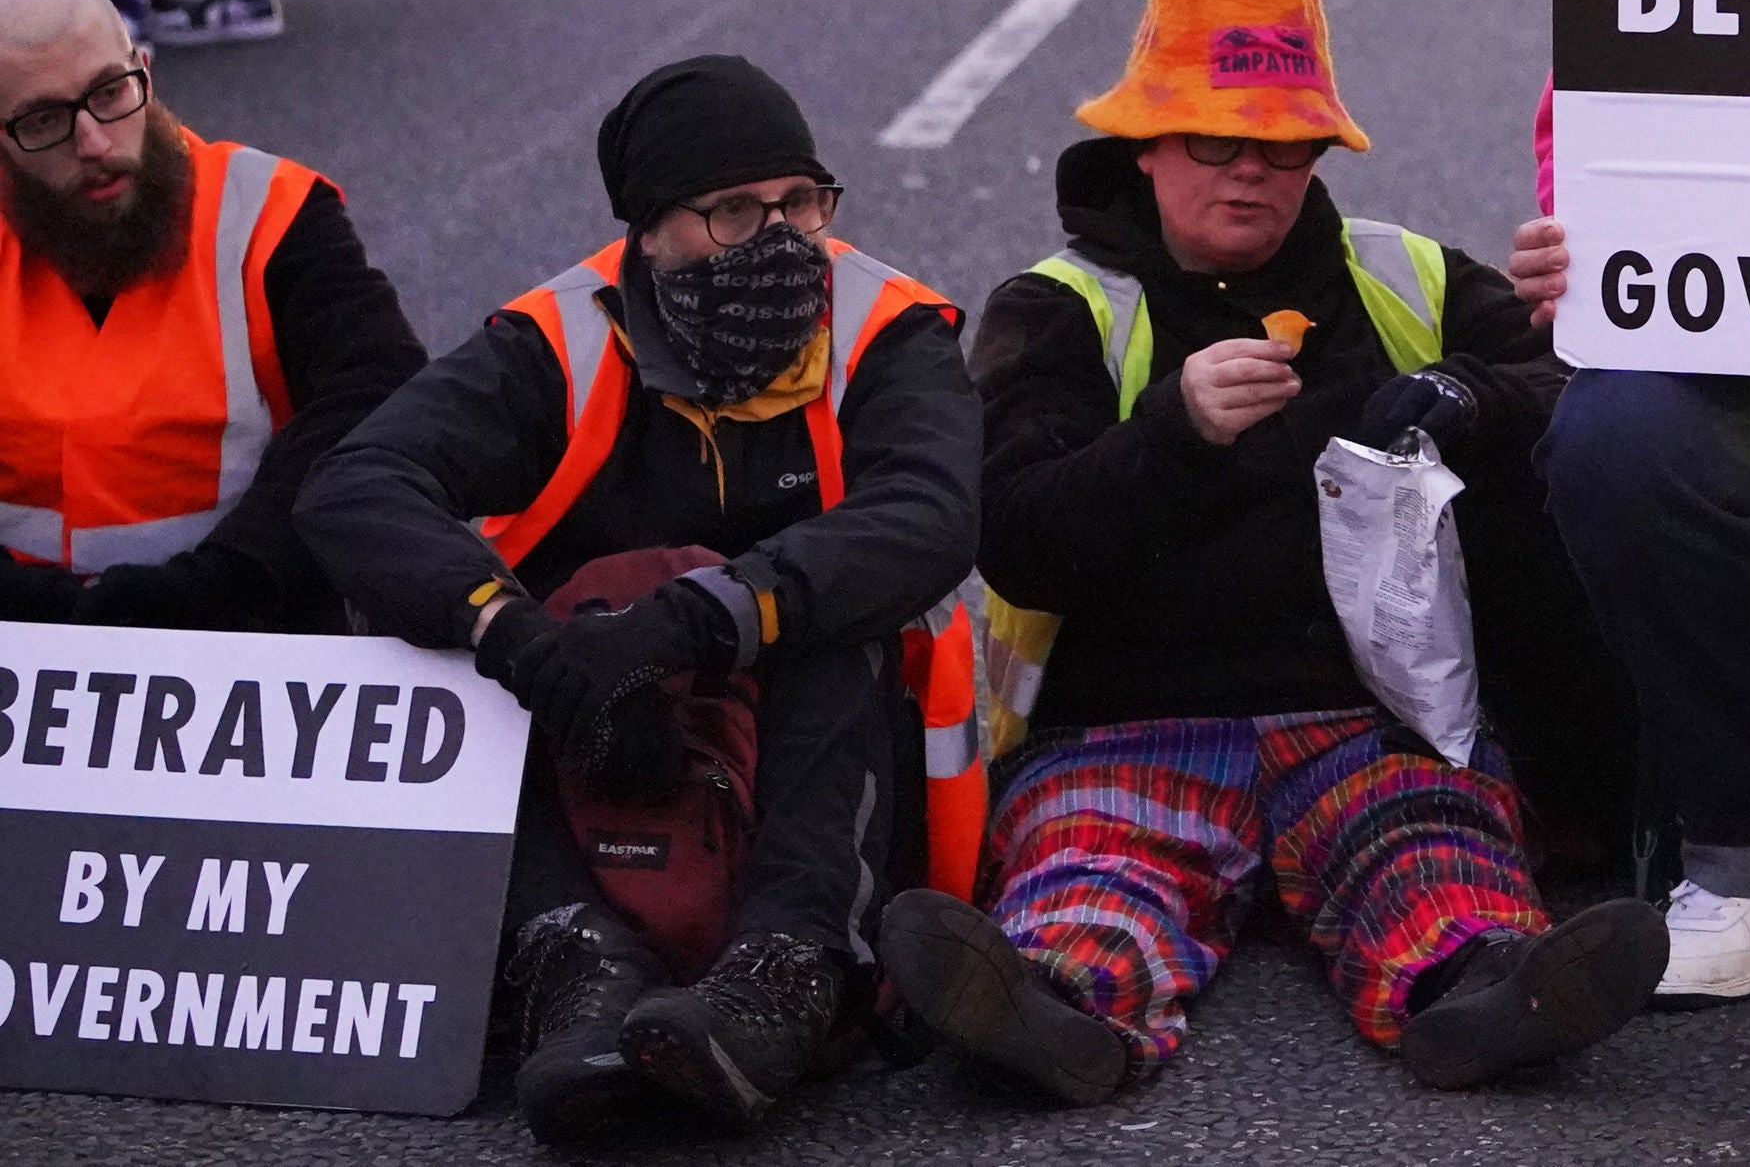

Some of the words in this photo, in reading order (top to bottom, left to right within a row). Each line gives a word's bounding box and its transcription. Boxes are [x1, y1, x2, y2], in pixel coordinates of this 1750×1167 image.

[1219, 50, 1316, 76] EMPATHY
[598, 843, 658, 856] EASTPAK
[59, 850, 166, 928] BY
[186, 858, 310, 935] MY
